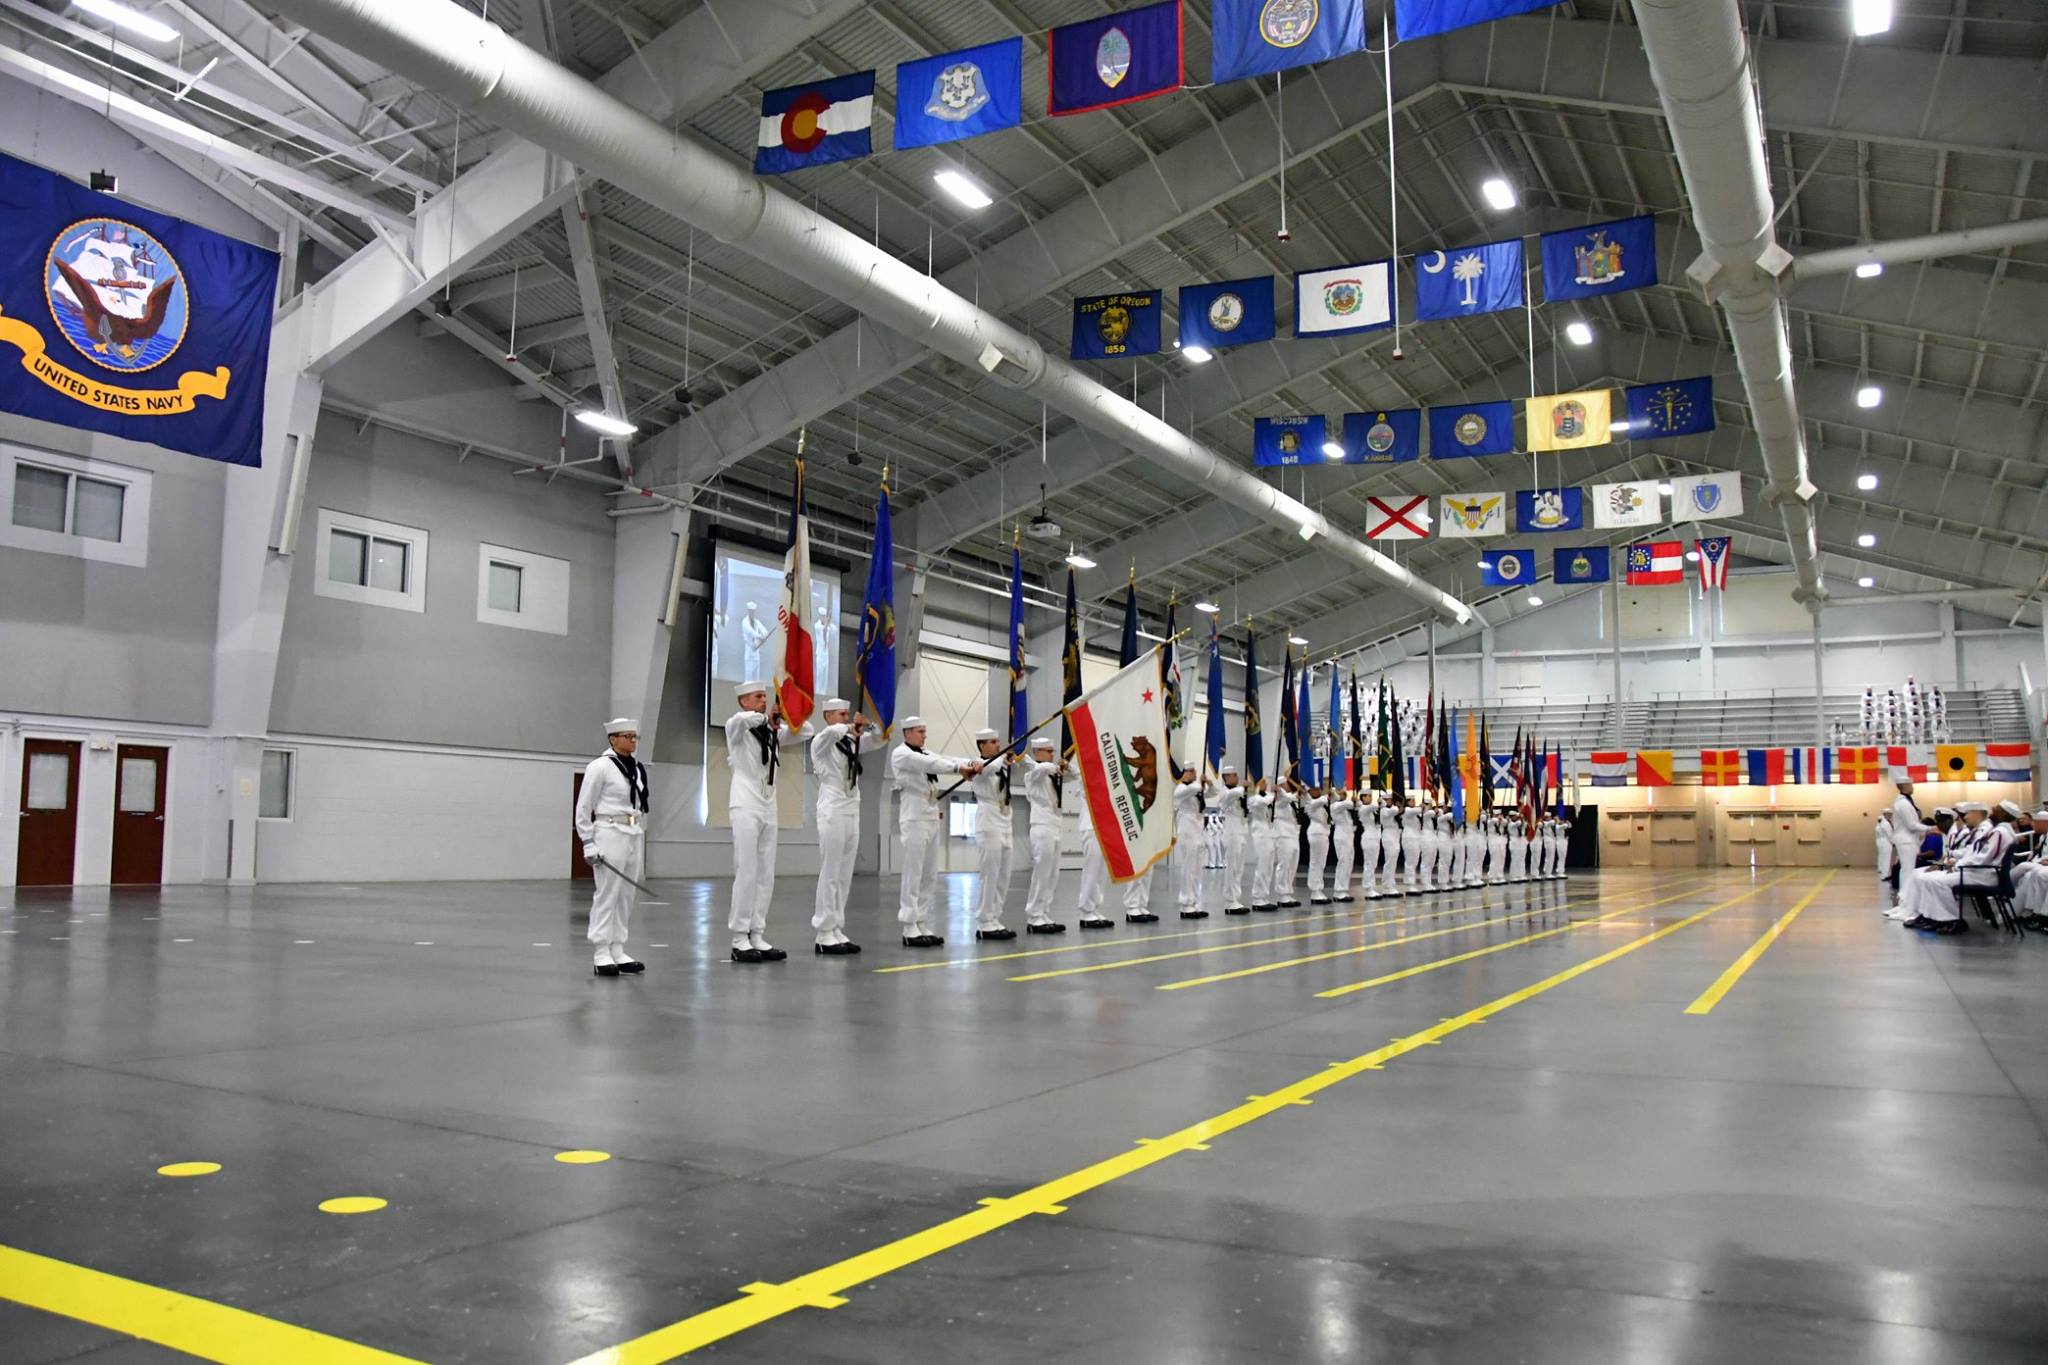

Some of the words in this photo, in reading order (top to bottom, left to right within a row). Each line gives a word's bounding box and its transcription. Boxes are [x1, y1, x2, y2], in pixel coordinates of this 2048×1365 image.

[1080, 299, 1106, 313] STATE
[1108, 296, 1119, 305] OF
[1120, 296, 1152, 306] OREGON
[1104, 345, 1126, 354] 1859
[33, 358, 88, 396] UNITED
[93, 390, 140, 410] STATES
[146, 395, 183, 410] NAVY
[1100, 732, 1121, 790] CALIFORNIA
[1115, 794, 1138, 841] REPUBLIC
